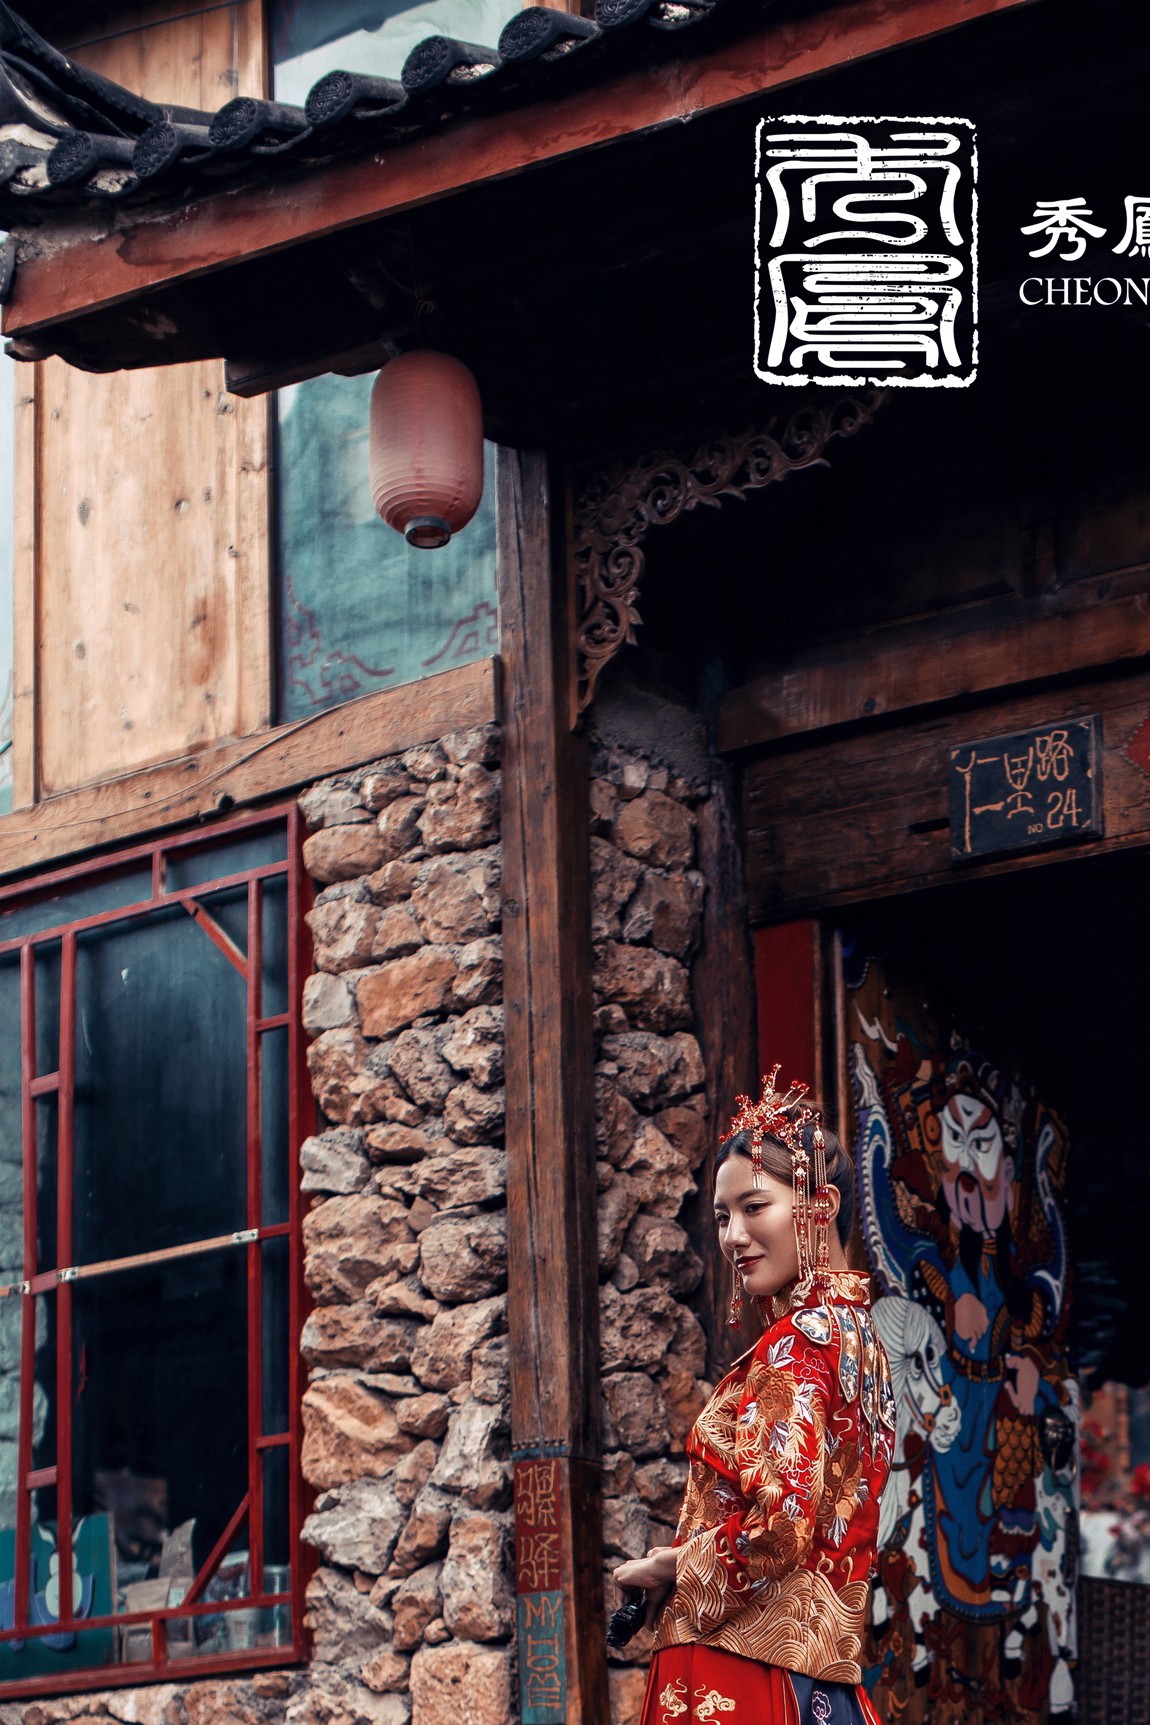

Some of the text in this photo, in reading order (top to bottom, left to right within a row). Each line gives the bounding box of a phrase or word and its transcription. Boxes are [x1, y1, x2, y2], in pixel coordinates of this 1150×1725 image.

[1046, 788, 1083, 829] 24
[523, 1596, 562, 1630] MY
[526, 1633, 562, 1709] HOME
